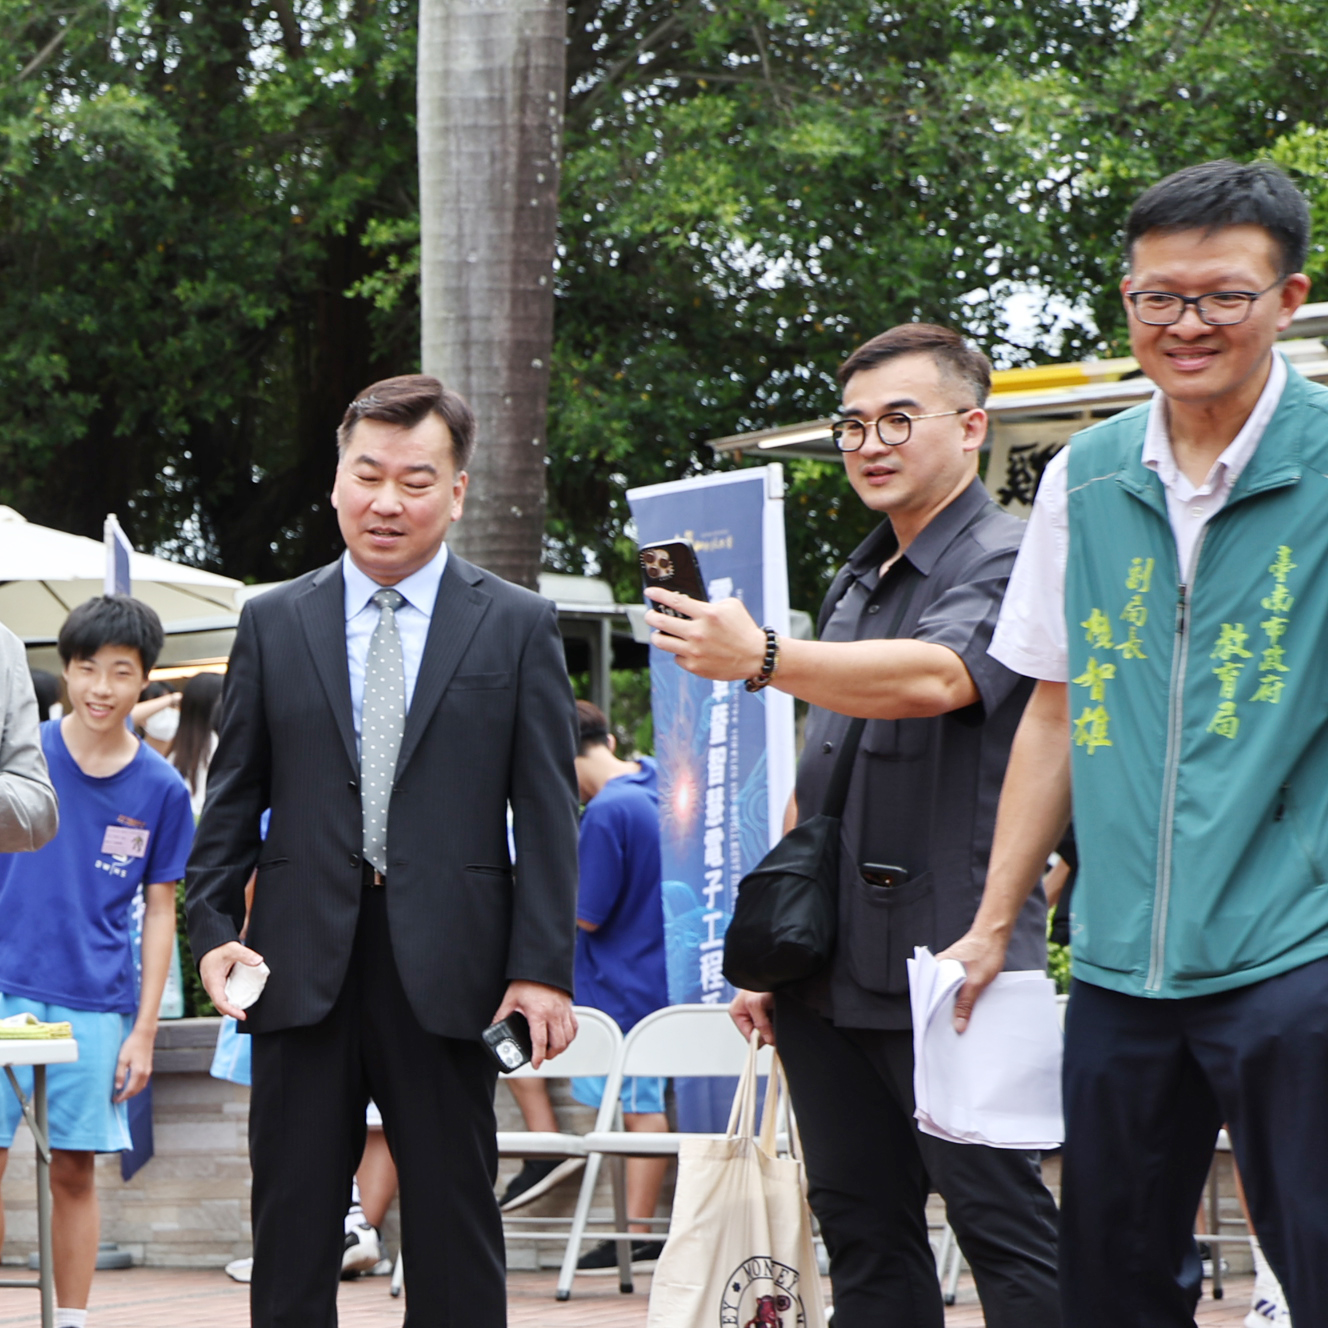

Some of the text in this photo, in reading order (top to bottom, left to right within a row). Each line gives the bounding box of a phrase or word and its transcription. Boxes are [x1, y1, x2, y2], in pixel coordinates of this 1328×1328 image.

[1114, 557, 1155, 660] 副局長
[1249, 545, 1297, 704] 臺南市政府
[1206, 622, 1254, 739] 教育局
